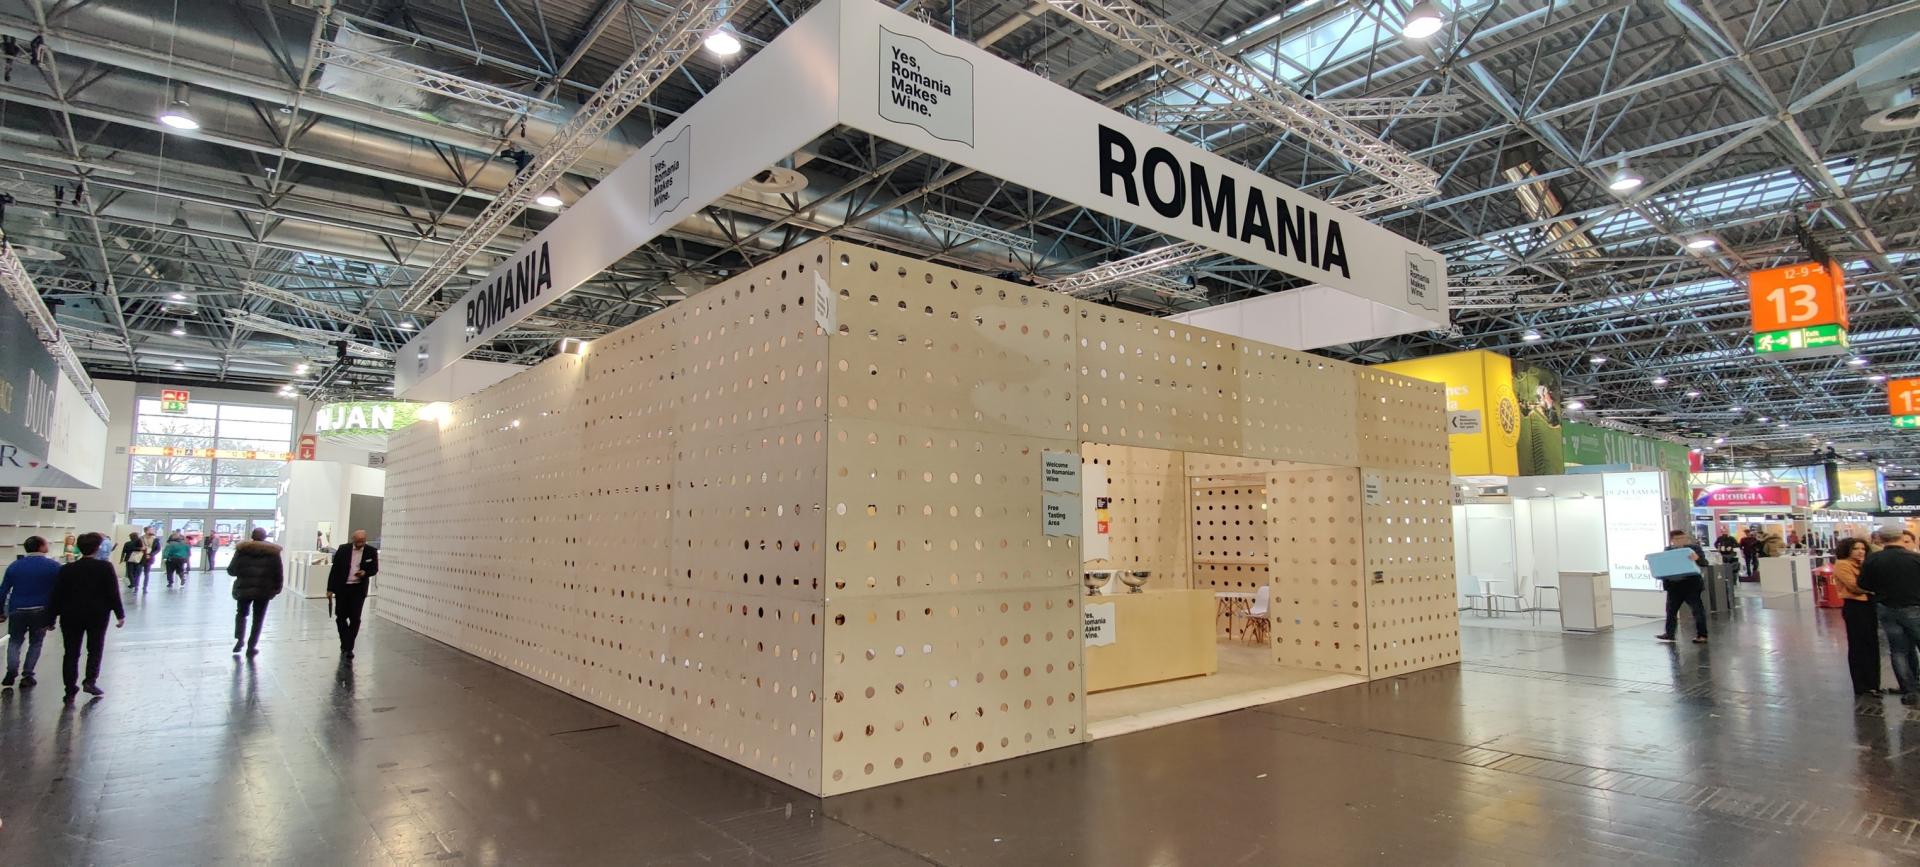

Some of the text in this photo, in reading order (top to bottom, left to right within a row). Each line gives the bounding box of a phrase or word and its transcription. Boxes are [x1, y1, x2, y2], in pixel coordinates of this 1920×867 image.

[891, 45, 921, 72] Yes,
[891, 60, 951, 96] Romania
[891, 75, 938, 105] Makes
[891, 90, 932, 117] Wine.
[1098, 123, 1351, 280] ROMANIA
[466, 241, 552, 343] ROMANIA
[1766, 284, 1820, 324] 13
[1712, 492, 1763, 501] GEORGIA
[1048, 512, 1066, 520] Tasting
